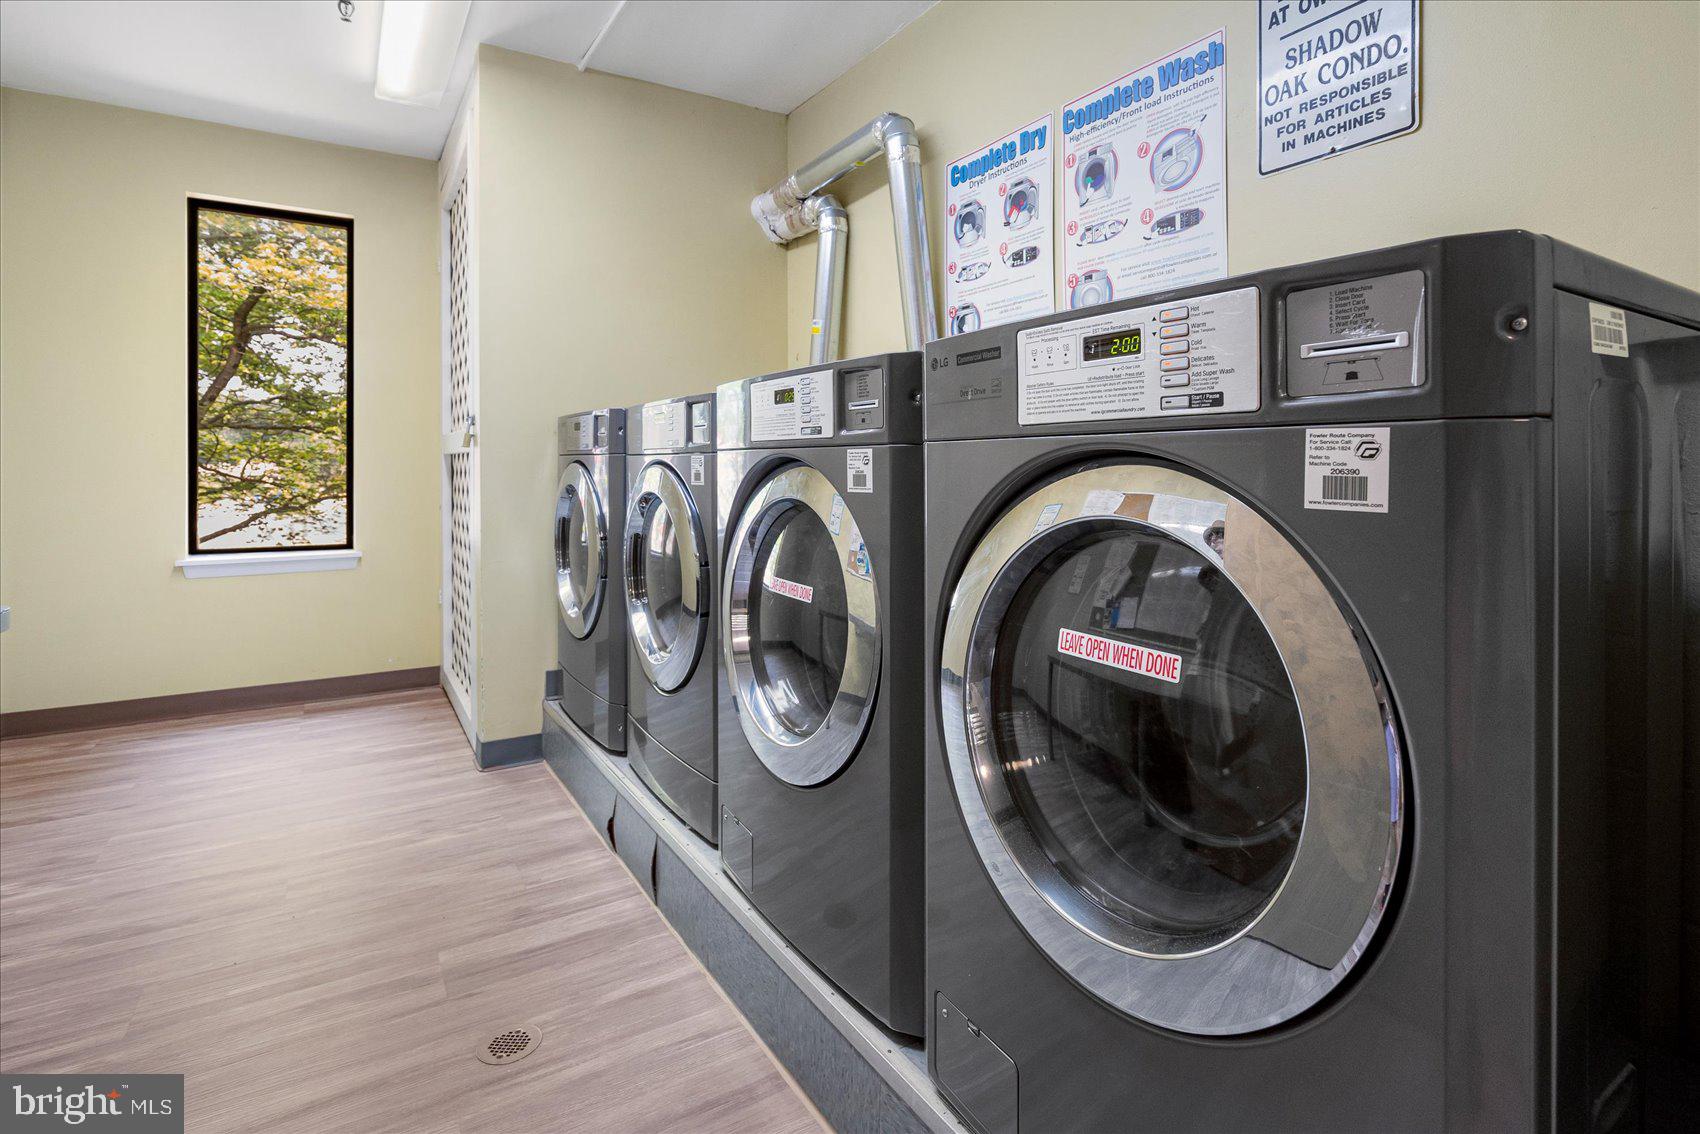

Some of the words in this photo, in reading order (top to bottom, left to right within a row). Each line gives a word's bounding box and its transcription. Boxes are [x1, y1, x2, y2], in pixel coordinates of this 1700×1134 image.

[1268, 4, 1290, 30] AT
[1285, 8, 1383, 70] SHADOW
[1063, 75, 1154, 134] Complete
[1158, 40, 1224, 91] Wash
[1265, 72, 1308, 106] OAK
[1318, 34, 1408, 85] CONDO.
[1264, 108, 1292, 127] NOT
[1300, 63, 1408, 114] RESPONSIBLE
[1276, 119, 1306, 138] FOR
[1314, 87, 1392, 125] ARTICLES
[1069, 106, 1143, 143] High-efficiency/Front
[1144, 97, 1162, 110] load
[1282, 138, 1296, 152] IN
[1304, 108, 1386, 145] MACHINES
[951, 140, 1017, 187] Complete
[1019, 125, 1047, 156] Dry
[969, 176, 986, 189] Dryer
[1335, 288, 1348, 296] Load
[1349, 285, 1373, 293] Machine
[1352, 298, 1366, 306] Card
[940, 357, 949, 368] LG
[1191, 355, 1215, 363] Delicates
[1060, 630, 1085, 655] LEAVE
[1085, 637, 1111, 662] OPEN
[1112, 643, 1144, 670] WHEN
[1145, 652, 1179, 680] DONE
